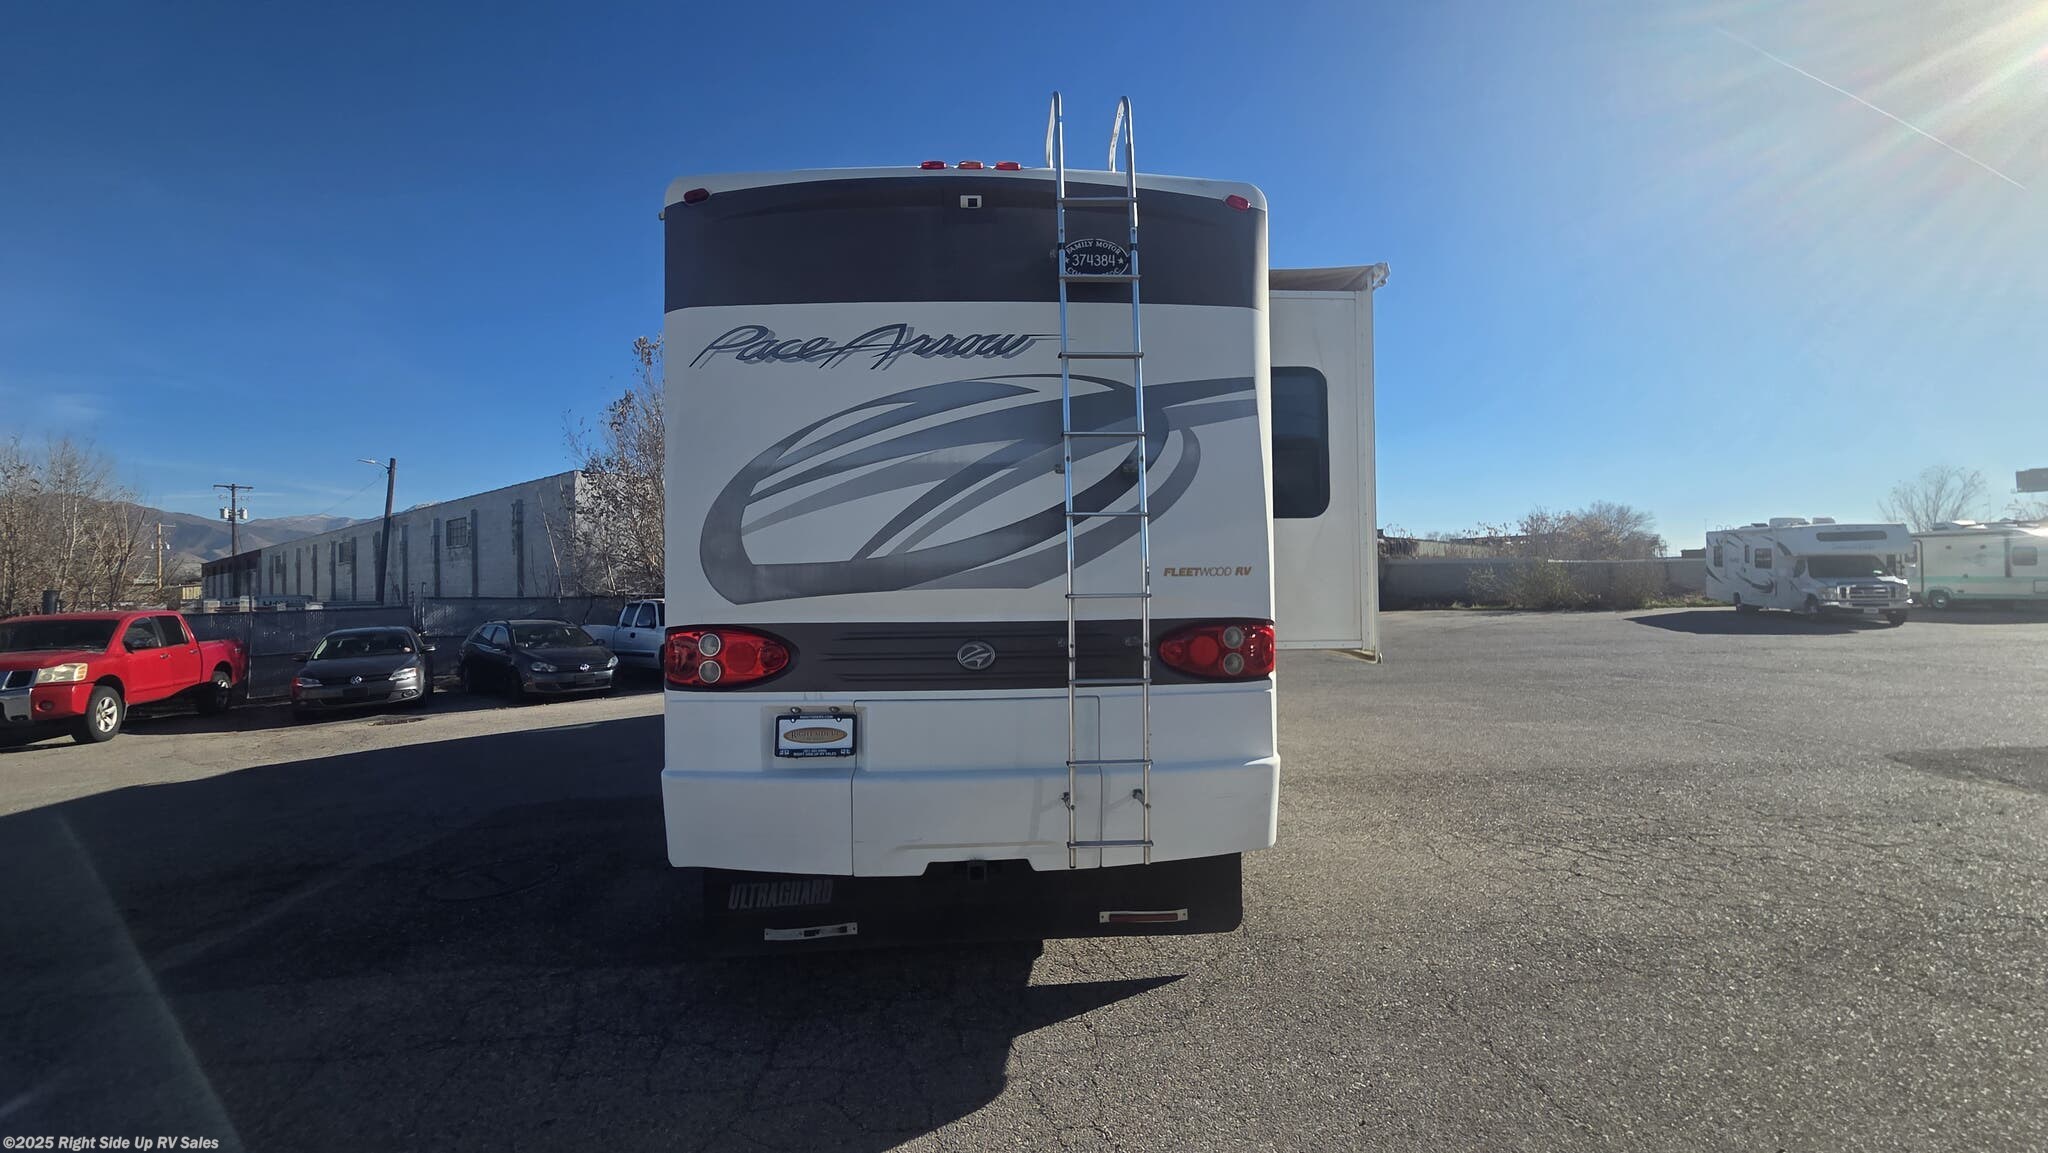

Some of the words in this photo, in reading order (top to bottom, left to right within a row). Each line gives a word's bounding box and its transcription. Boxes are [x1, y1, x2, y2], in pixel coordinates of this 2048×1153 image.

[1066, 241, 1093, 254] FAMILY
[1096, 241, 1121, 254] MOTOR
[1072, 254, 1115, 267] 374384
[689, 324, 836, 368] Pace
[818, 323, 1048, 370] Arrow
[1163, 567, 1232, 576] FLEETWOOD
[1235, 566, 1252, 576] RV
[728, 879, 834, 910] ULTRAGUARD
